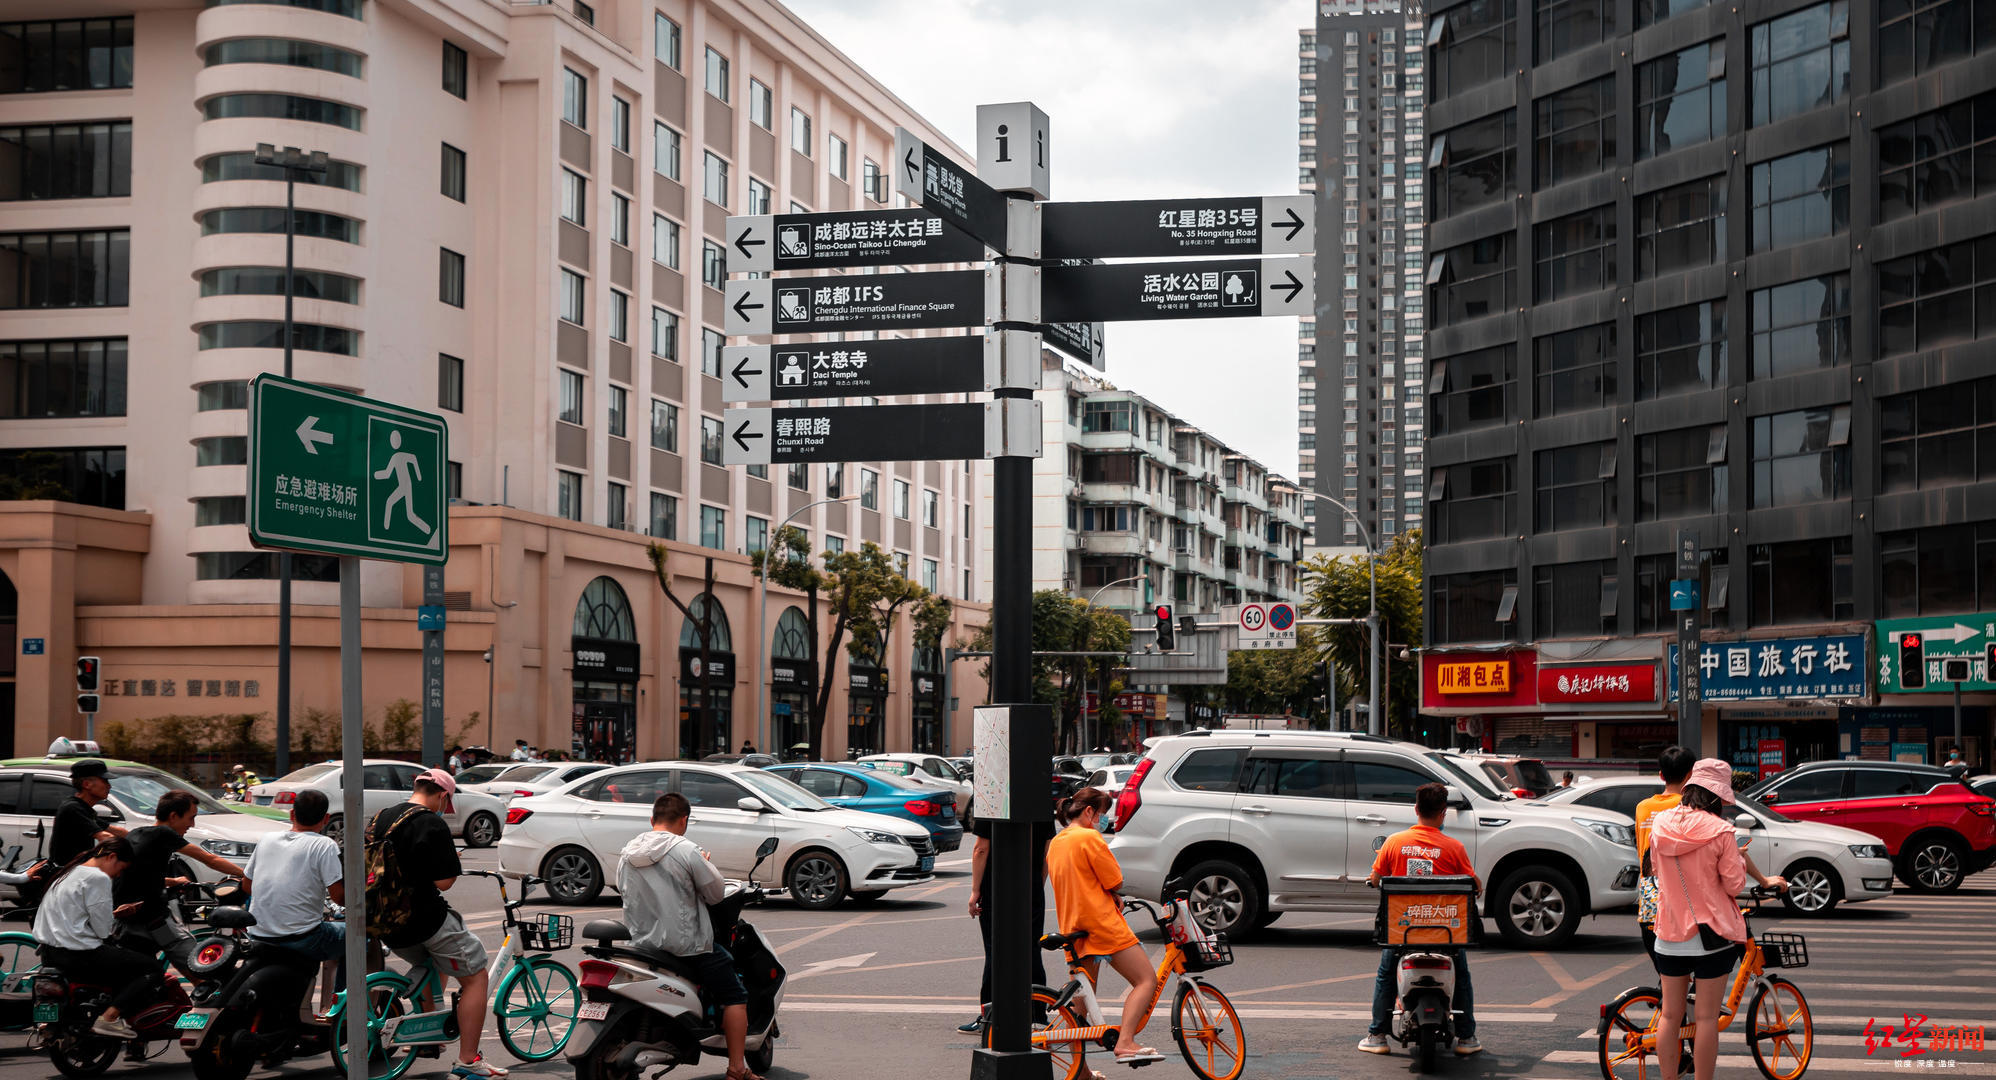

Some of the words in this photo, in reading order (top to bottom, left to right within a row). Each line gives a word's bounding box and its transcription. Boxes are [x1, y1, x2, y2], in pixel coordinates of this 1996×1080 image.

[995, 124, 1012, 162] i
[940, 166, 964, 199] 恩光堂
[1159, 208, 1258, 228] 红星路35号
[814, 218, 943, 241] 成都远洋太古里
[1171, 230, 1184, 238] No.
[1186, 230, 1196, 238] 35
[1197, 230, 1234, 238] Hongxing
[814, 241, 857, 251] Sino-Ocean
[858, 241, 882, 249] Taikoo
[884, 240, 892, 248] Li
[892, 239, 927, 248] Chengdu
[1143, 272, 1219, 293] 活水公园
[814, 286, 850, 305] 成都
[854, 285, 884, 302] IFS
[1141, 294, 1164, 303] Living
[1165, 293, 1188, 302] Water
[1189, 292, 1218, 301] Garden
[814, 306, 848, 316] Chengdu
[849, 304, 897, 314] International
[898, 303, 926, 311] Finance
[928, 302, 955, 312] Square
[812, 350, 868, 369] 大慈寺
[813, 371, 829, 379] Daci
[831, 371, 858, 380] Temple
[776, 417, 831, 437] 春熙路
[776, 438, 803, 446] Chunxi
[804, 437, 824, 445] Road
[275, 474, 358, 507] 应急避难场所
[275, 498, 325, 518] Emergency
[326, 506, 357, 520] Shelter
[1245, 610, 1261, 624] 60
[1685, 618, 1694, 630] F
[430, 639, 439, 648] A
[1699, 642, 1852, 679] 中国旅行社
[1440, 665, 1505, 687] 川湘包点
[1401, 845, 1441, 859] 碎屏大师
[1407, 904, 1458, 918] 碎屏大师
